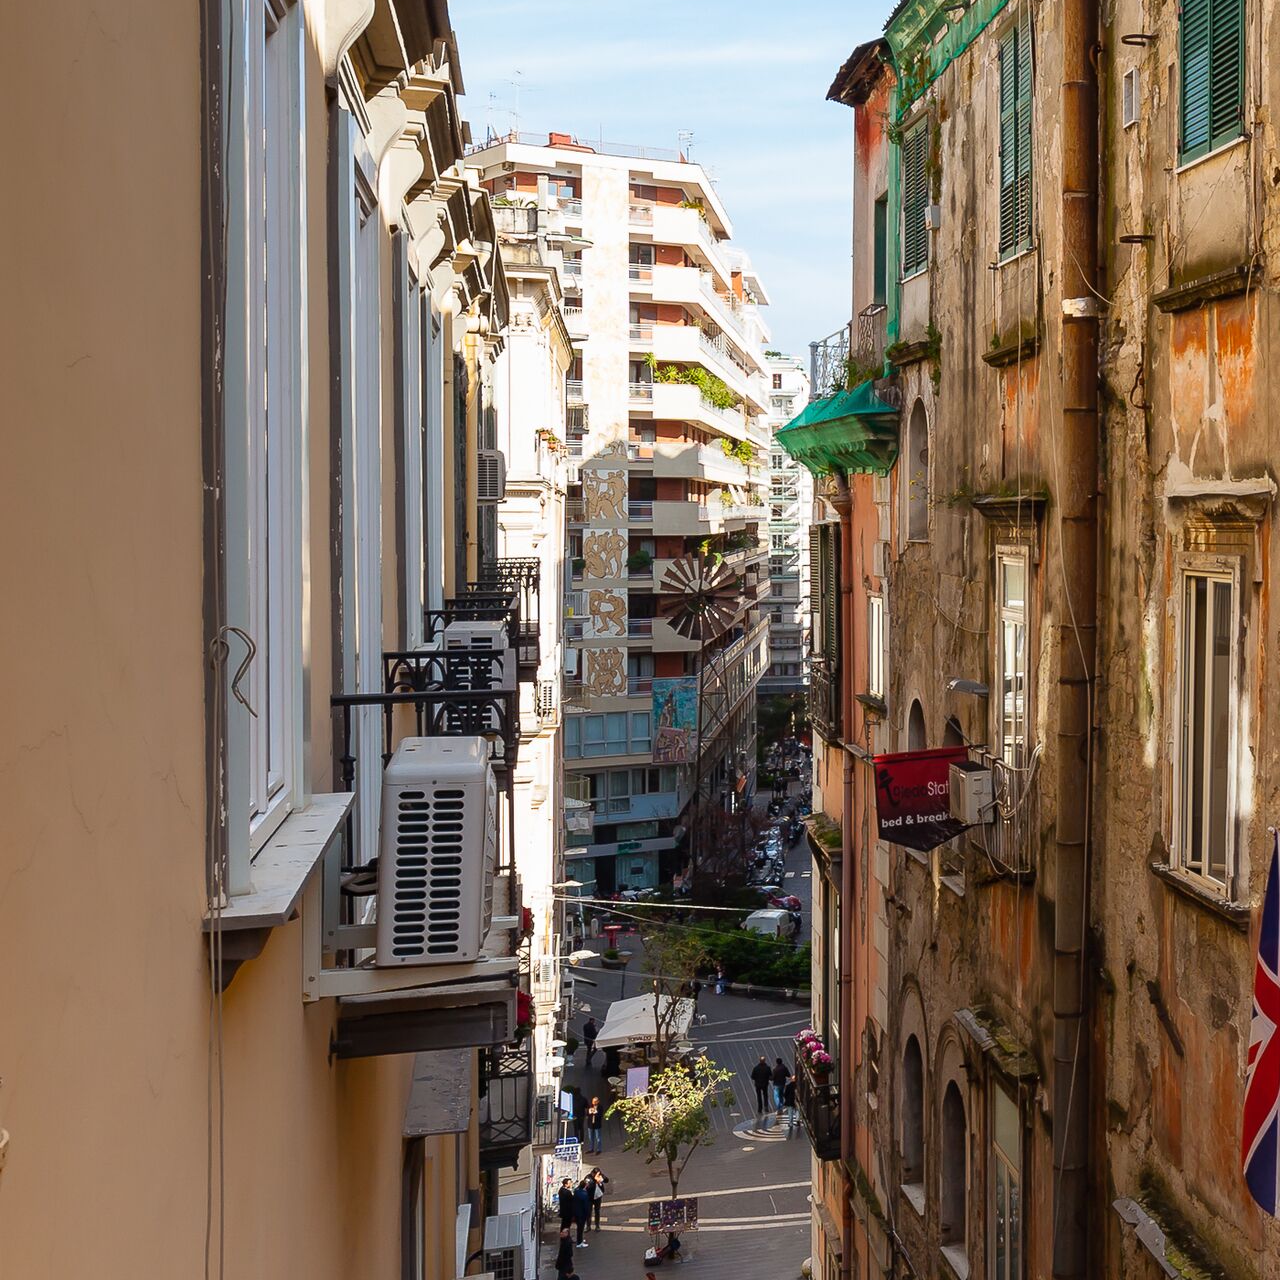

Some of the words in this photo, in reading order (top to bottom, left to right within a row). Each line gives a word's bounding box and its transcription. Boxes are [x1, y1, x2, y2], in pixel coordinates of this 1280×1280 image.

[881, 816, 903, 828] bed
[905, 814, 914, 825] &
[916, 811, 952, 824] break
